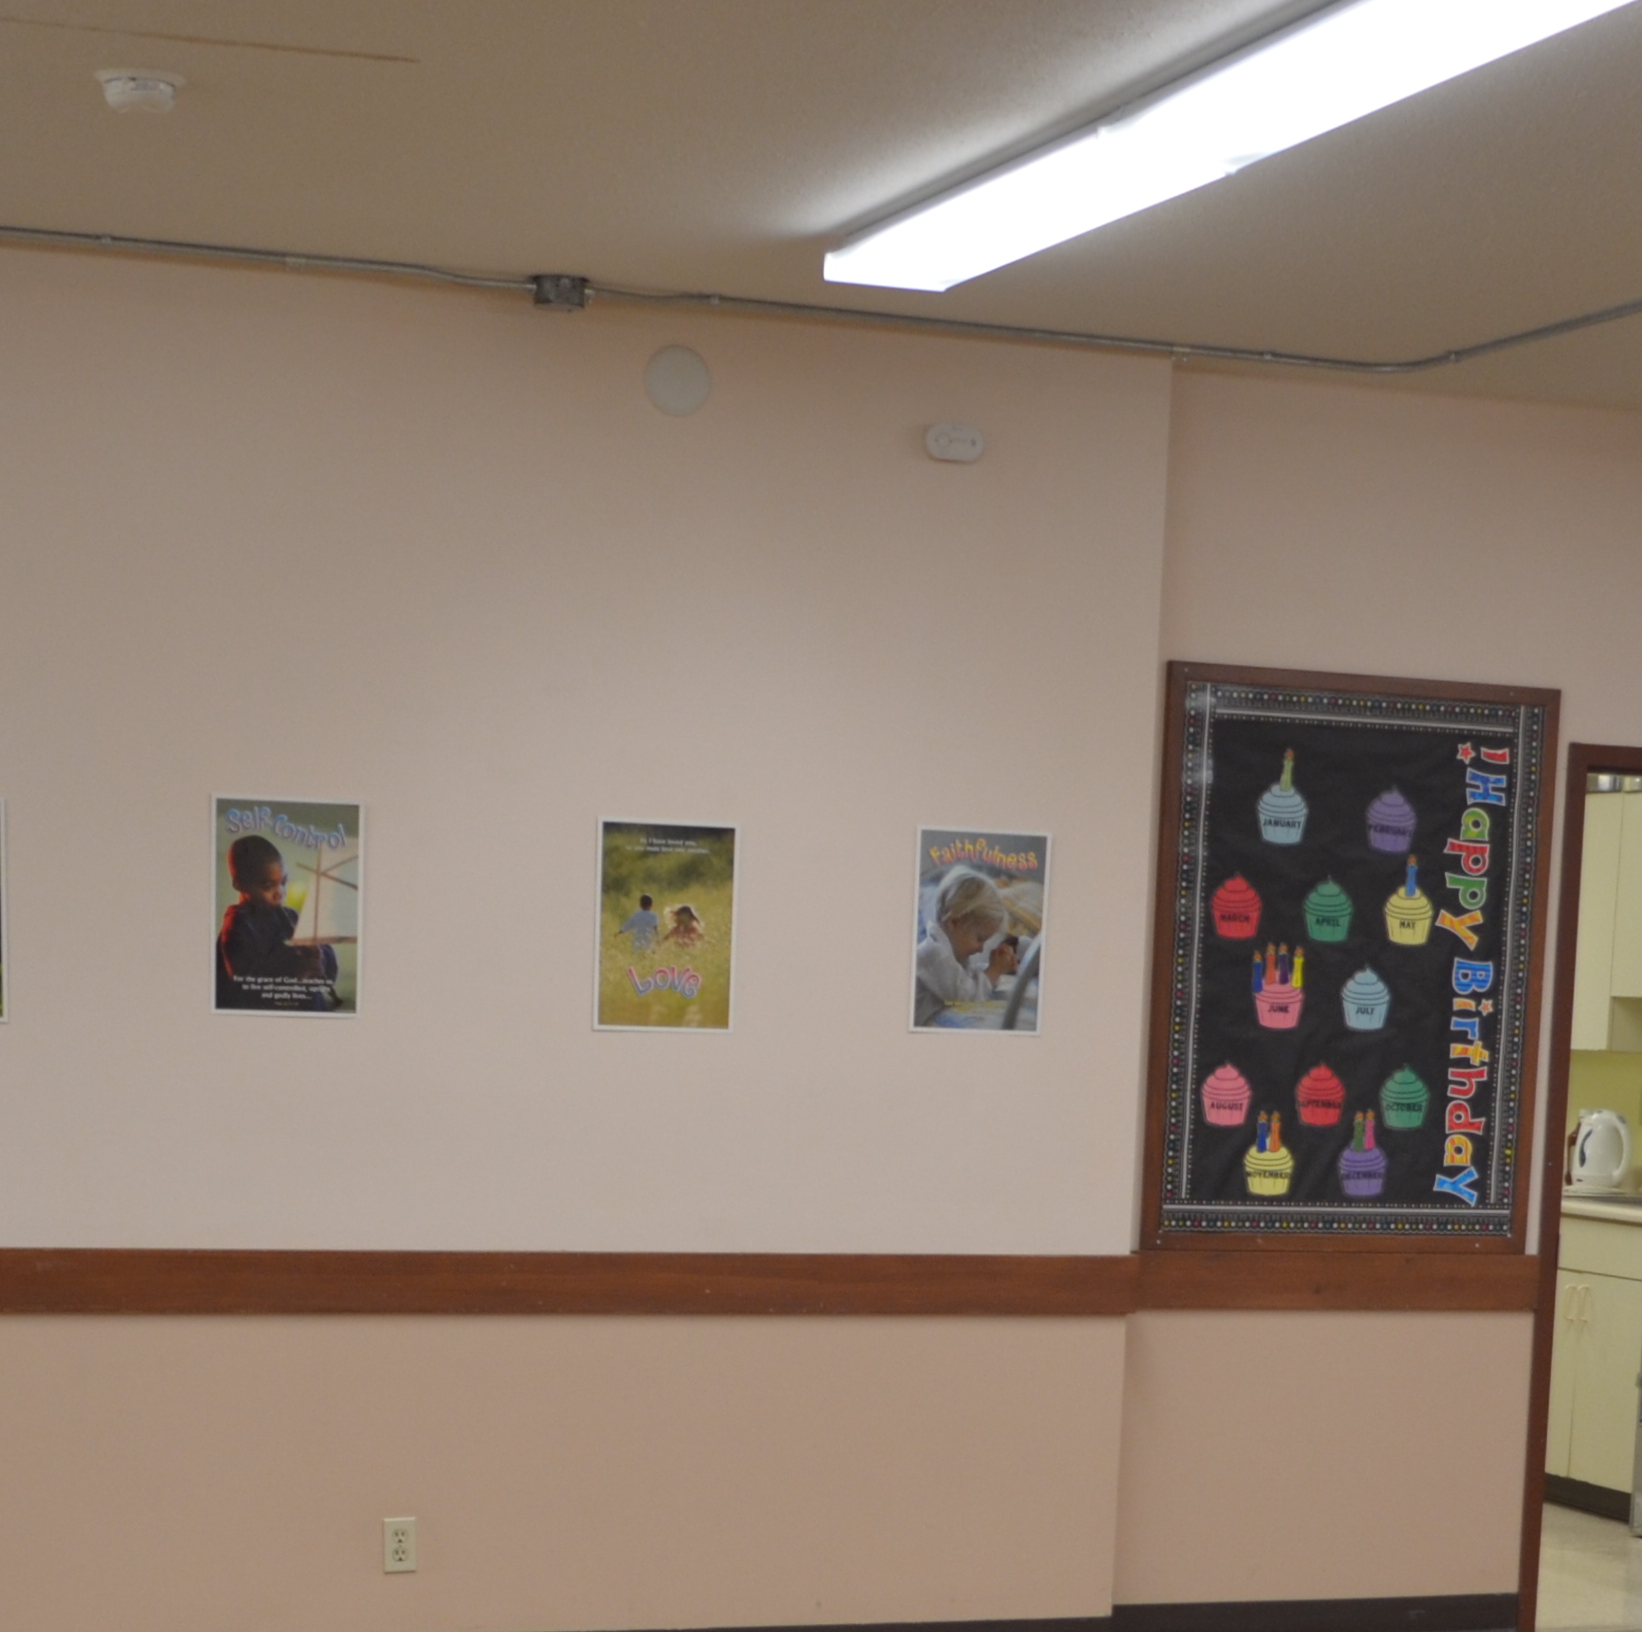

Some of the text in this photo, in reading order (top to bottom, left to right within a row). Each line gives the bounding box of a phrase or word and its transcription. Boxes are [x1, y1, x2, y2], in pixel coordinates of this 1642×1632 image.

[225, 806, 348, 850] Self-Control
[1263, 818, 1302, 829] JANUARY
[1369, 824, 1412, 837] FEBRUARY
[929, 838, 1038, 870] Faithfulness
[1220, 913, 1250, 923] MARCH
[1315, 917, 1341, 928] APRIL
[1399, 919, 1417, 930] MAY
[1268, 1004, 1289, 1013] JUNE
[1355, 1006, 1375, 1015] JULY
[1432, 957, 1494, 1207] Birthday
[1209, 1102, 1243, 1111] AUGUST
[1299, 1099, 1344, 1111] SEPTEMBER
[1385, 1102, 1423, 1113] OCTOBER
[1246, 1170, 1291, 1179] NOVEMBER
